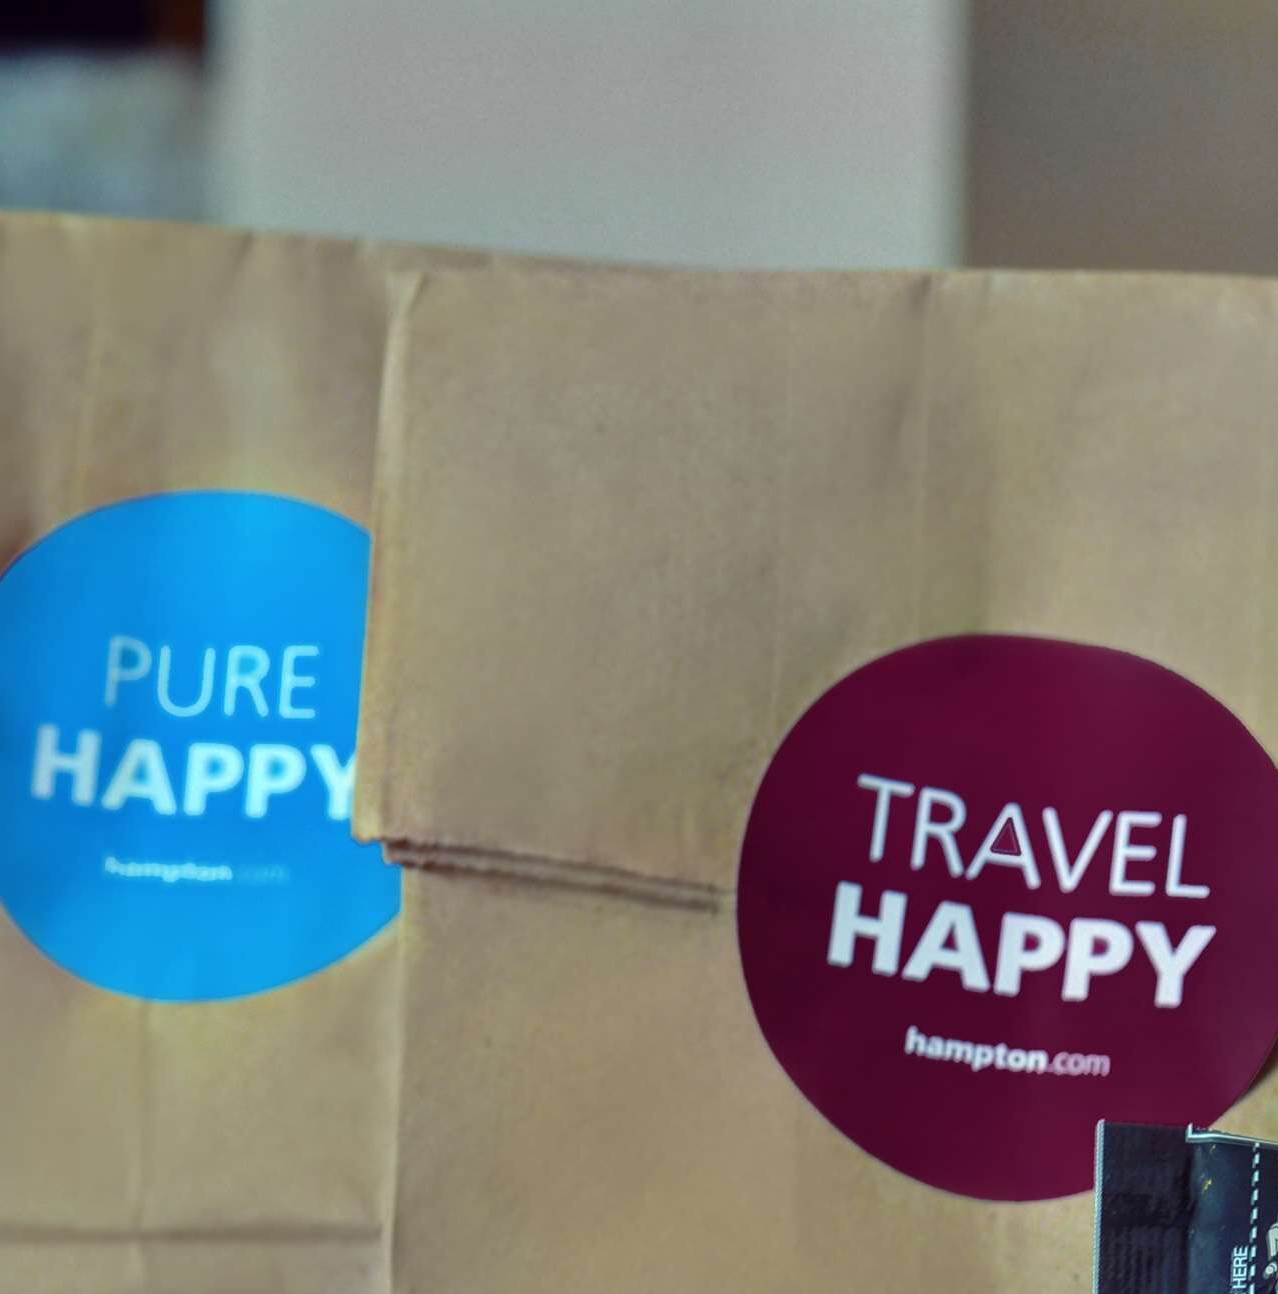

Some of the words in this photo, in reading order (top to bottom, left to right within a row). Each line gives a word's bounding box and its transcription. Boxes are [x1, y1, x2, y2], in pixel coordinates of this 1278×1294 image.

[104, 634, 319, 719] PURE
[31, 723, 358, 821] HAPPY
[857, 772, 1212, 900] TRAVEL
[826, 880, 1217, 1009] HAPPY
[905, 1025, 1111, 1078] hampton.com
[1232, 1244, 1249, 1289] HERE
